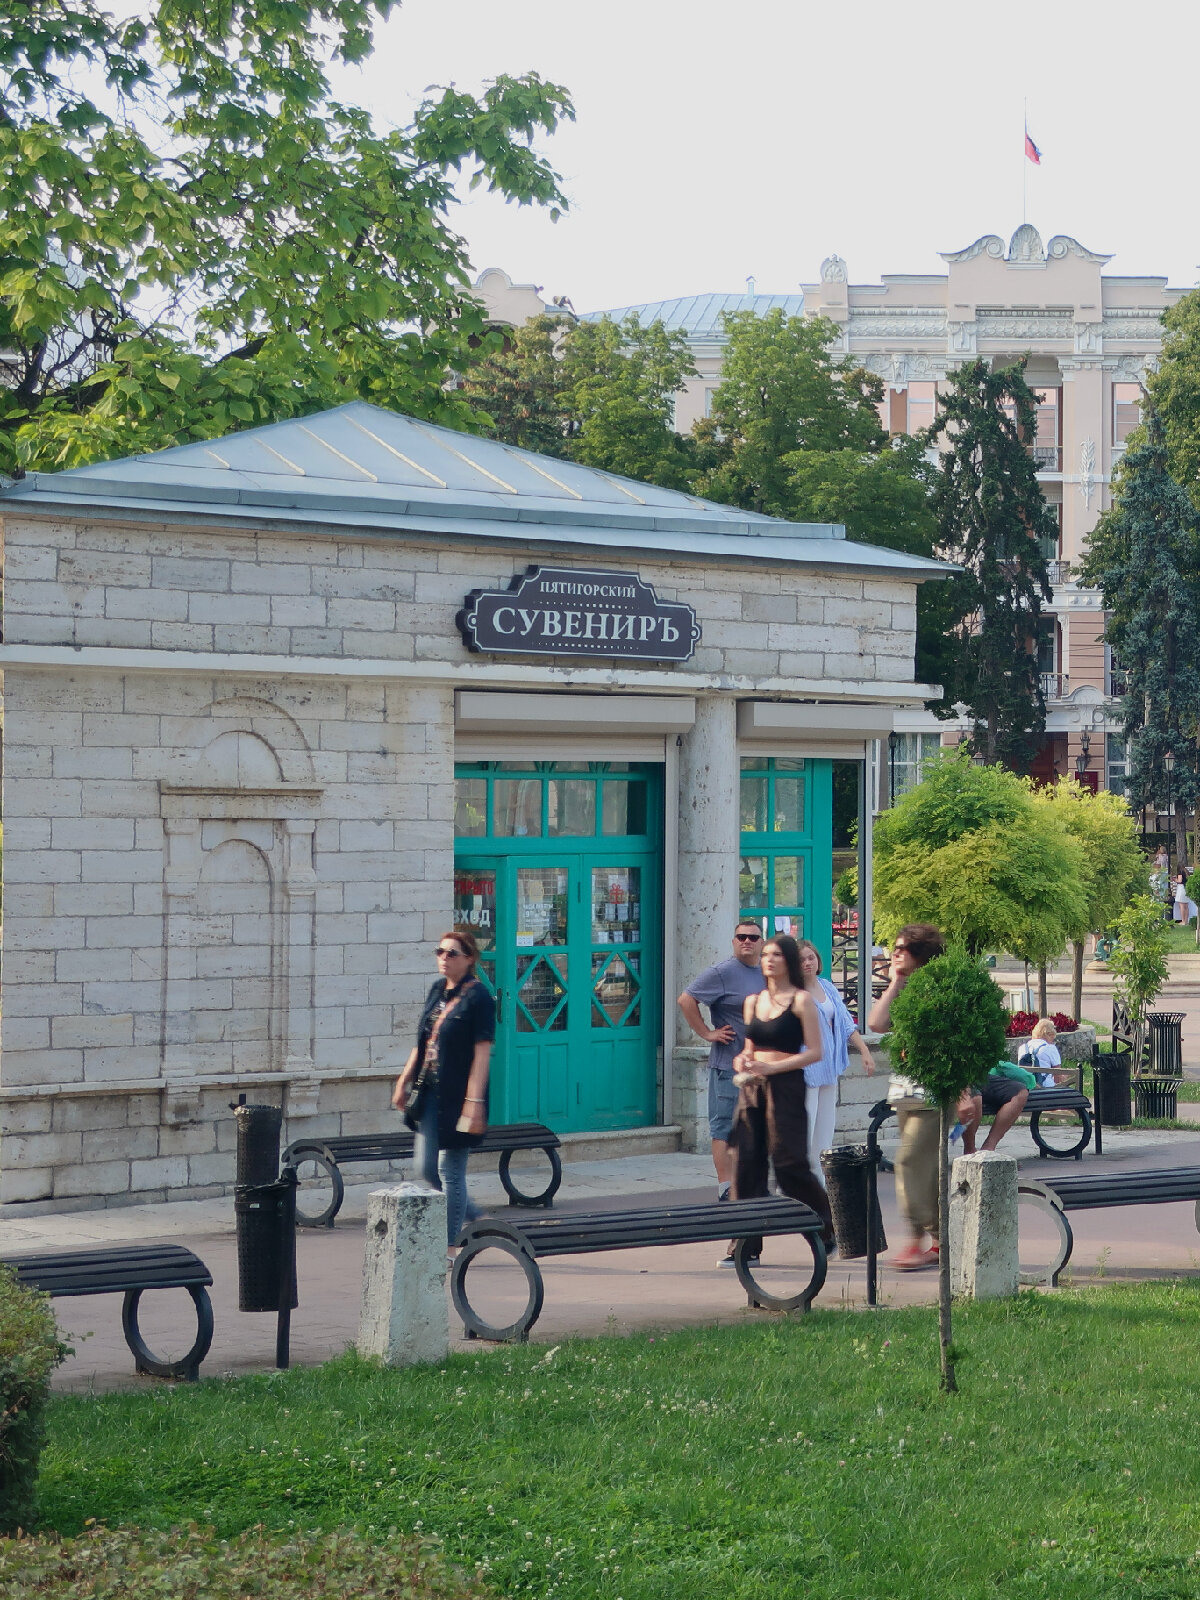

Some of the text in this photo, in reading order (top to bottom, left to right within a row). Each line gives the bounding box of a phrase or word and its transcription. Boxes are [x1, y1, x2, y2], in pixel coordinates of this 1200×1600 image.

[540, 581, 636, 598] ПЯТИГОРСКИЙ
[492, 606, 680, 643] СУВЕНИРЪ
[453, 879, 494, 895] ТКРЫТО
